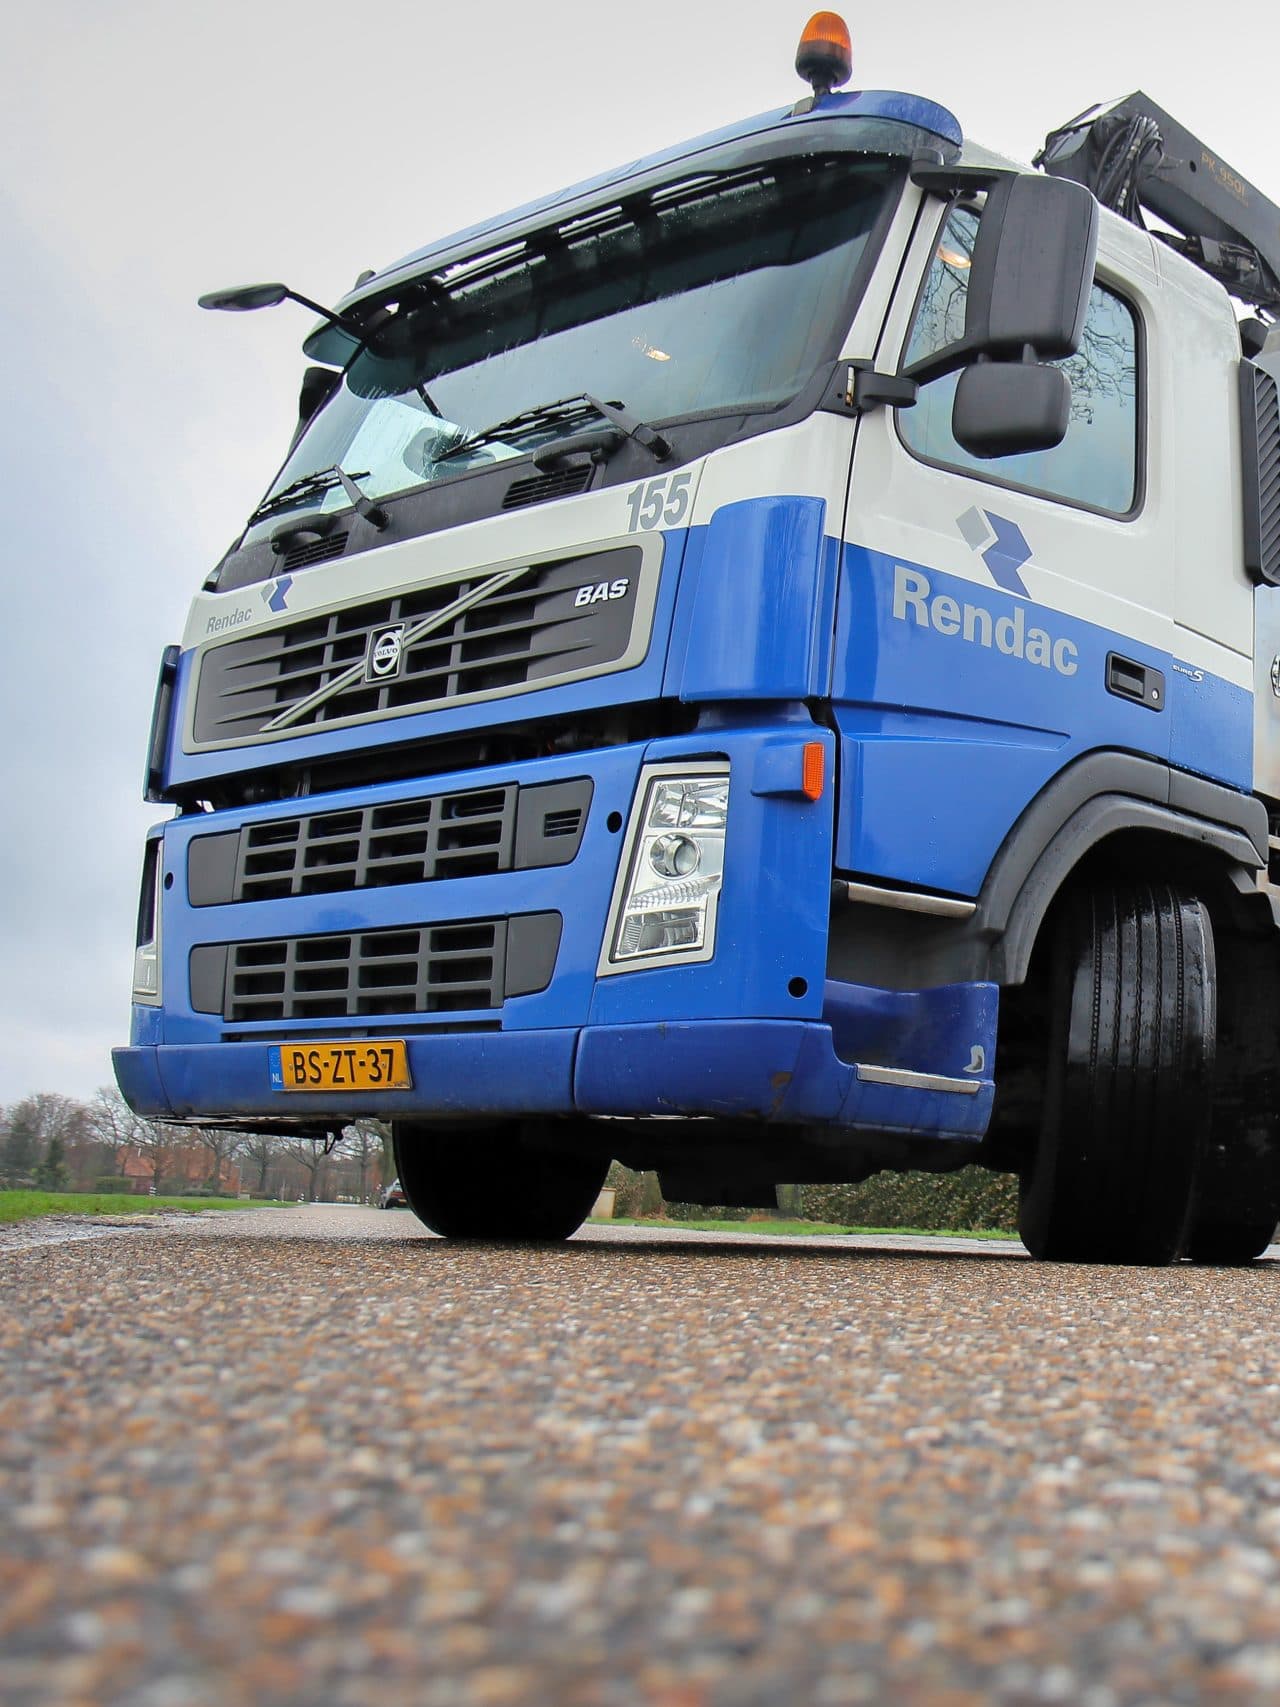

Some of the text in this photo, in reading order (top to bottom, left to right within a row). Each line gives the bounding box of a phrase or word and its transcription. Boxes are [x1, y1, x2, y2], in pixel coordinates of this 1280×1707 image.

[626, 472, 692, 533] 155
[574, 578, 629, 608] BAS
[206, 607, 253, 634] Rendac
[892, 565, 1079, 677] Rendac
[272, 1048, 395, 1084] NL BS-ZT-37
